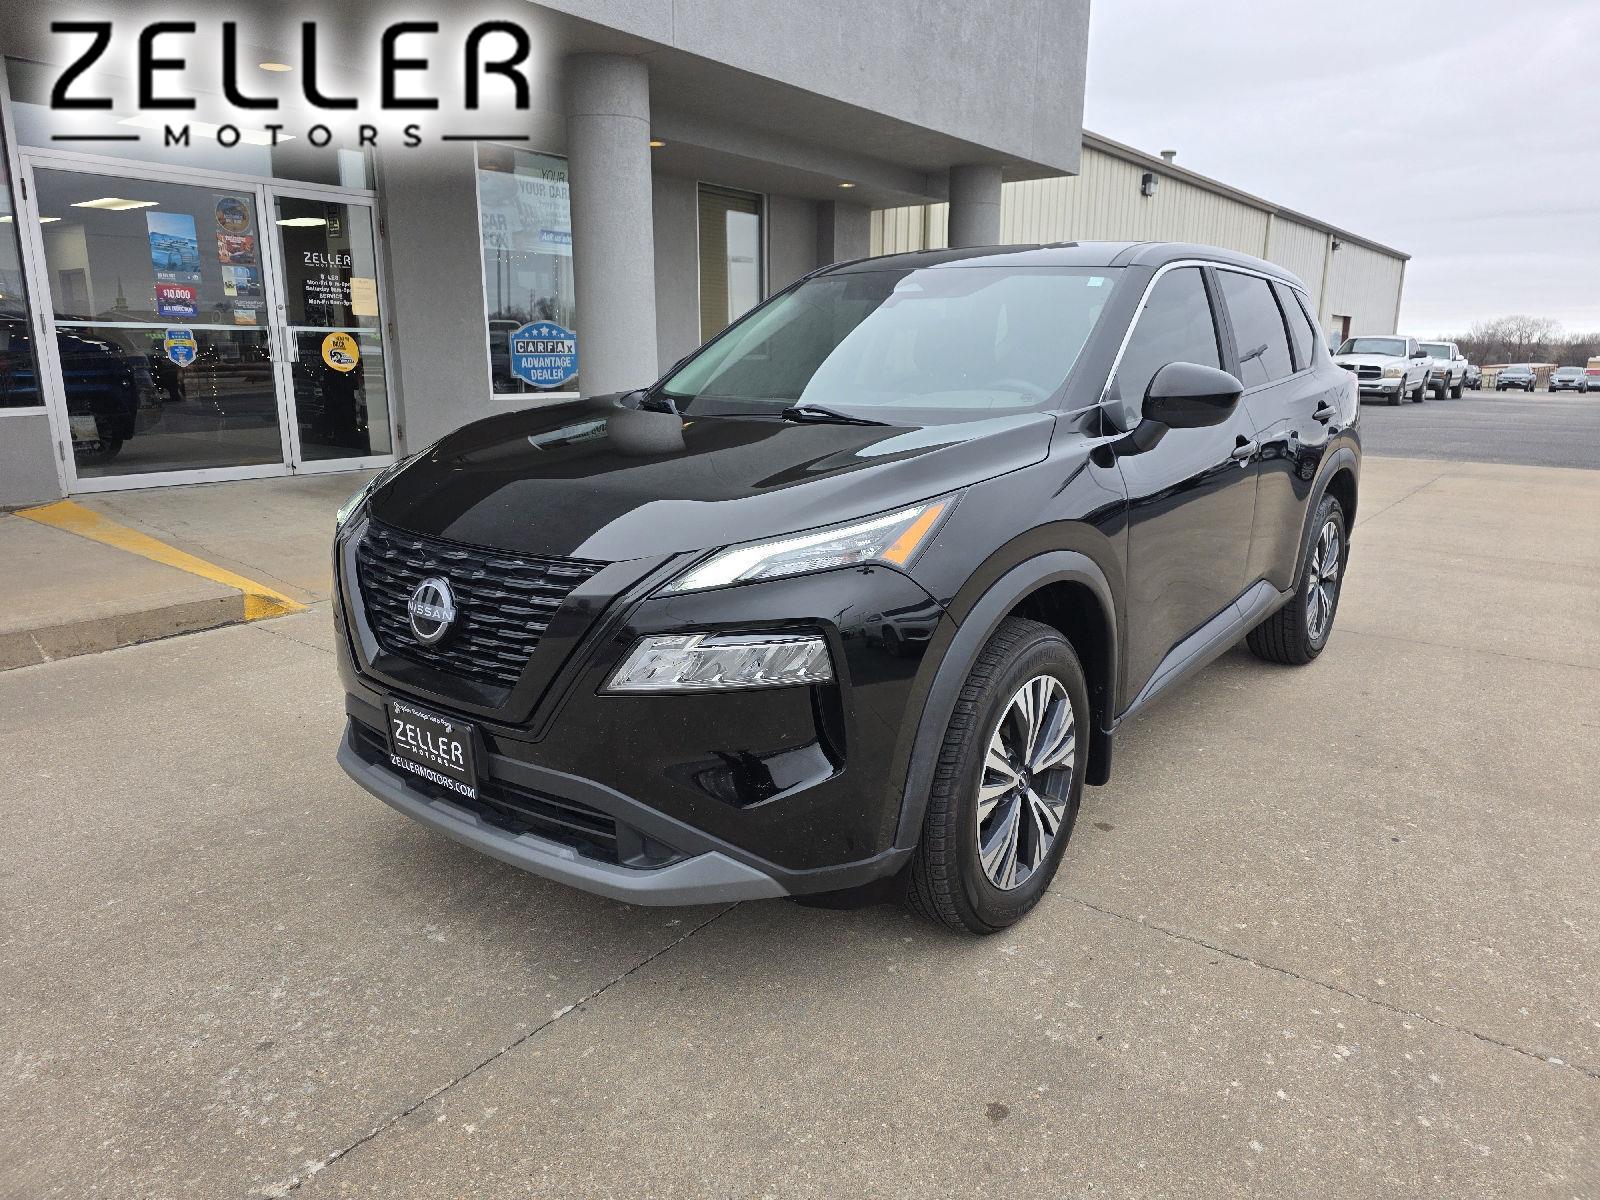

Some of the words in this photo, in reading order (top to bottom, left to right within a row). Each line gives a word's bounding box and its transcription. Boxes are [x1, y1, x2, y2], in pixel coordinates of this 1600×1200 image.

[303, 251, 351, 266] ZELLER
[163, 289, 191, 300] $10,000
[517, 341, 573, 354] CARFAX
[521, 356, 572, 368] ADVANTAGE
[530, 369, 564, 380] DEALER
[408, 600, 453, 621] NISSAN
[393, 718, 464, 765] ZELLER
[390, 753, 477, 801] ZELLERMOTORS.COM
